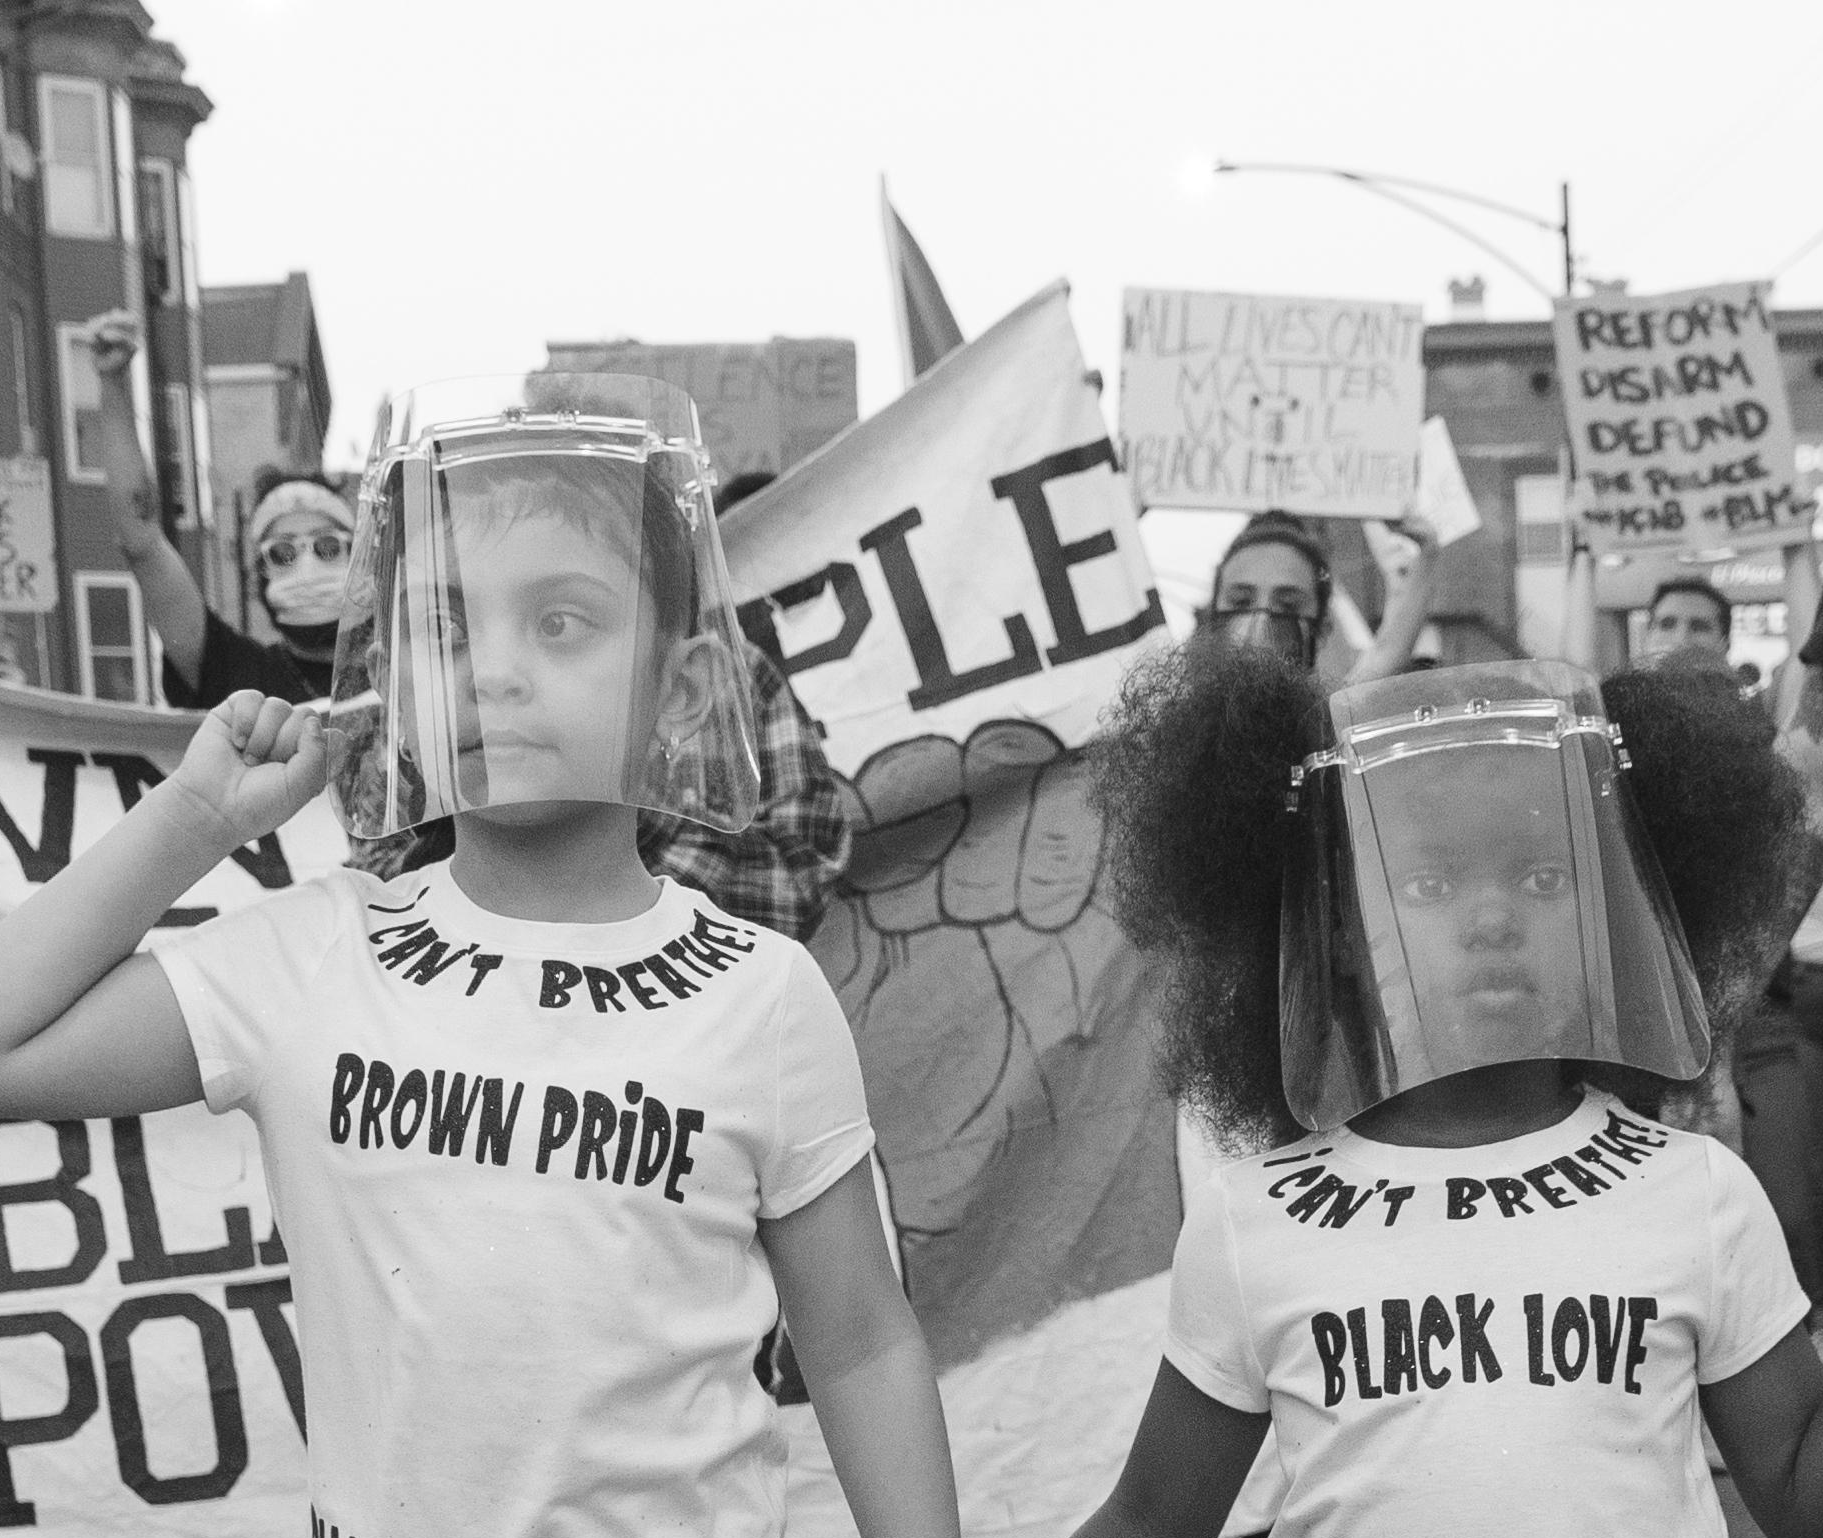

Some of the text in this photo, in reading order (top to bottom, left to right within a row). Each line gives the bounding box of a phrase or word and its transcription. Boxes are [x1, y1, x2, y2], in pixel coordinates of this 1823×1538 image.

[1577, 287, 1769, 351] REFORM
[1177, 355, 1399, 402] MATTER
[1580, 351, 1753, 404] DISARM
[1588, 400, 1768, 456] DEFUND
[371, 920, 503, 998] CAN'T
[537, 908, 760, 1016] BREATHE!
[329, 1052, 525, 1169] BROWN
[1267, 1168, 1416, 1230] CAN'T
[1445, 1108, 1670, 1222] BREATHE!
[1311, 1292, 1659, 1409] BLACK LOVE
